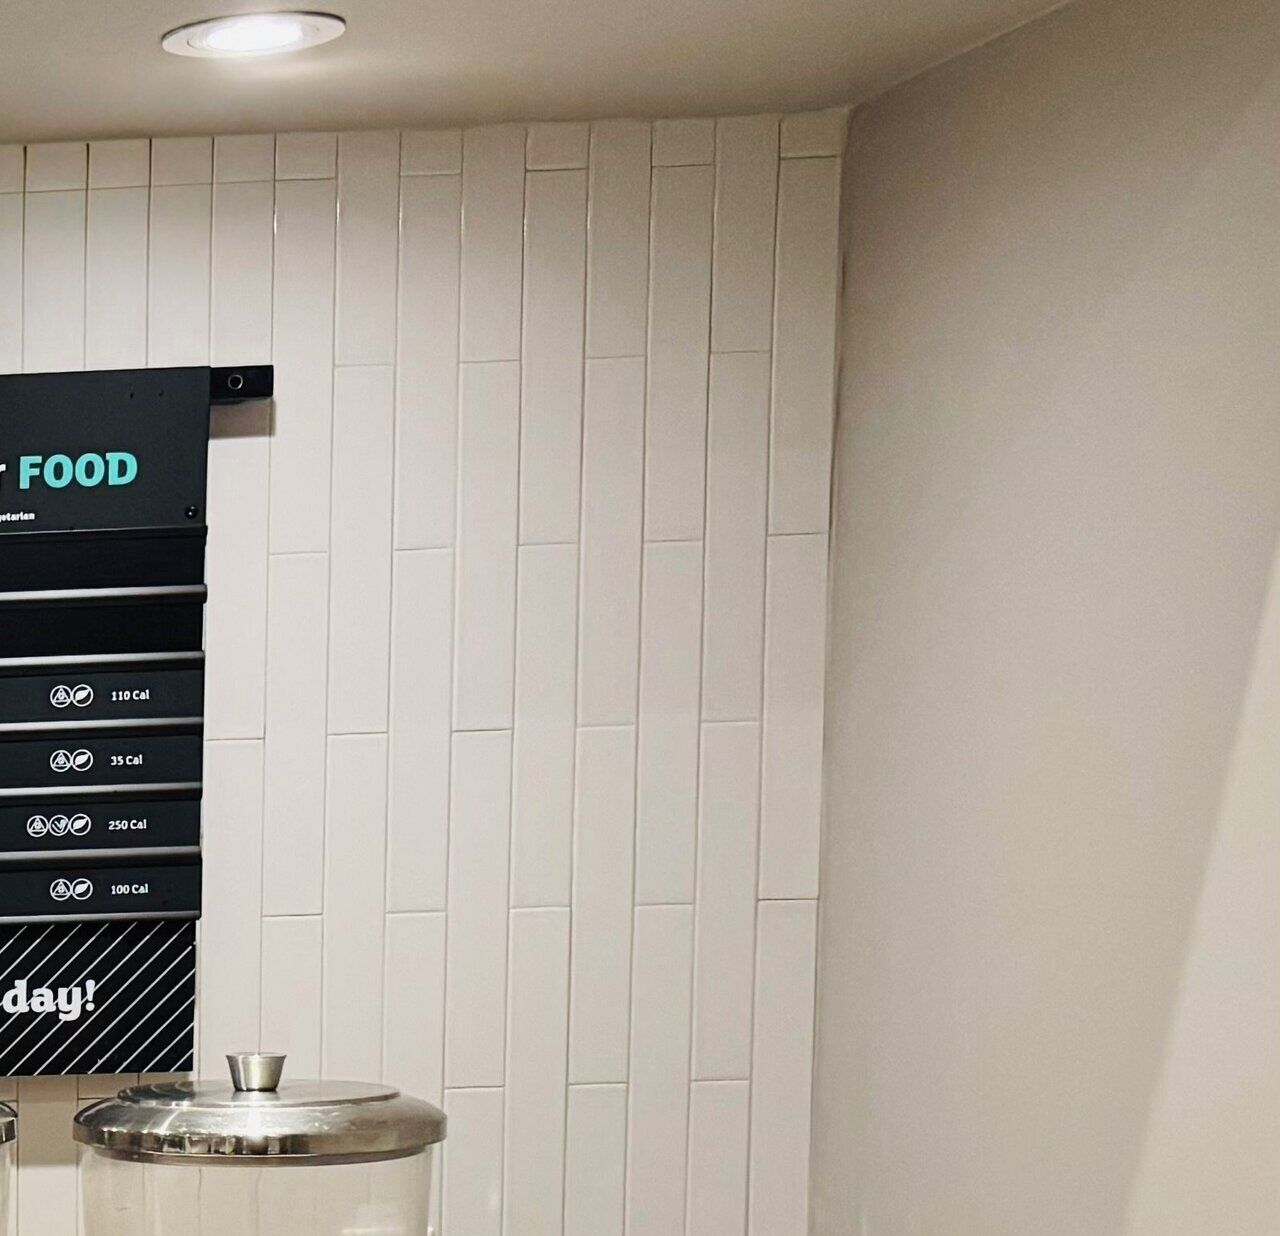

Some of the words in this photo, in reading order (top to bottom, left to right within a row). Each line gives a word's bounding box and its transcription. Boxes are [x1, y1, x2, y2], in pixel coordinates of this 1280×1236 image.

[20, 452, 137, 489] FOOD
[112, 691, 130, 701] 110
[133, 689, 149, 700] Cal
[111, 756, 123, 765] 35
[126, 754, 142, 765] Cal
[109, 820, 128, 830] 250
[130, 819, 146, 829] Cal
[111, 885, 130, 894] 100
[132, 884, 148, 894] Cal
[2, 979, 96, 1022] day!
